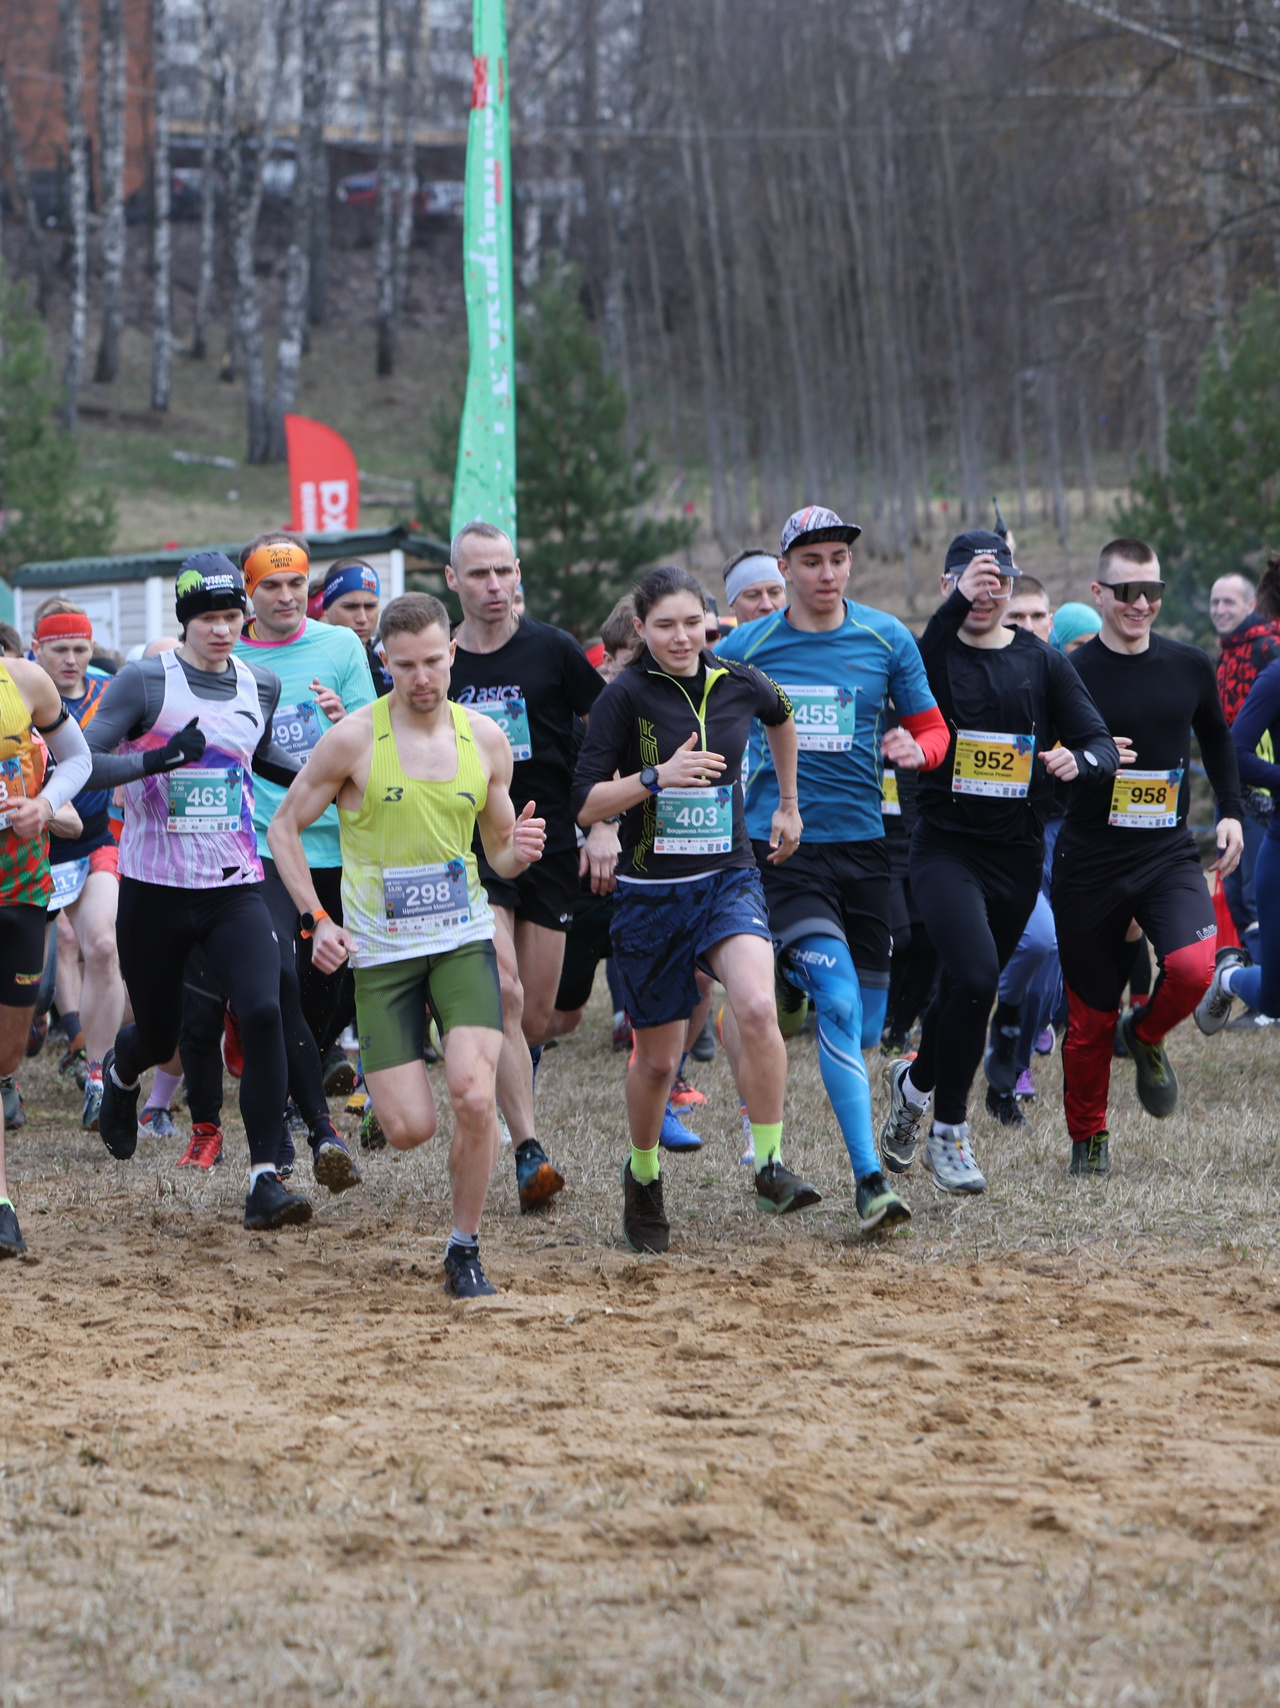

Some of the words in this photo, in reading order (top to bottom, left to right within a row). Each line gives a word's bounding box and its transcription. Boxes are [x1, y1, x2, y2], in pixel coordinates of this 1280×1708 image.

[270, 557, 282, 565] MAD
[795, 704, 838, 724] 455
[272, 722, 303, 744] 99
[974, 750, 1014, 771] 952
[187, 786, 227, 806] 463
[1131, 787, 1167, 804] 958
[675, 806, 718, 827] 403
[52, 872, 79, 891] 17
[405, 881, 451, 906] 298
[433, 901, 456, 910] Максим
